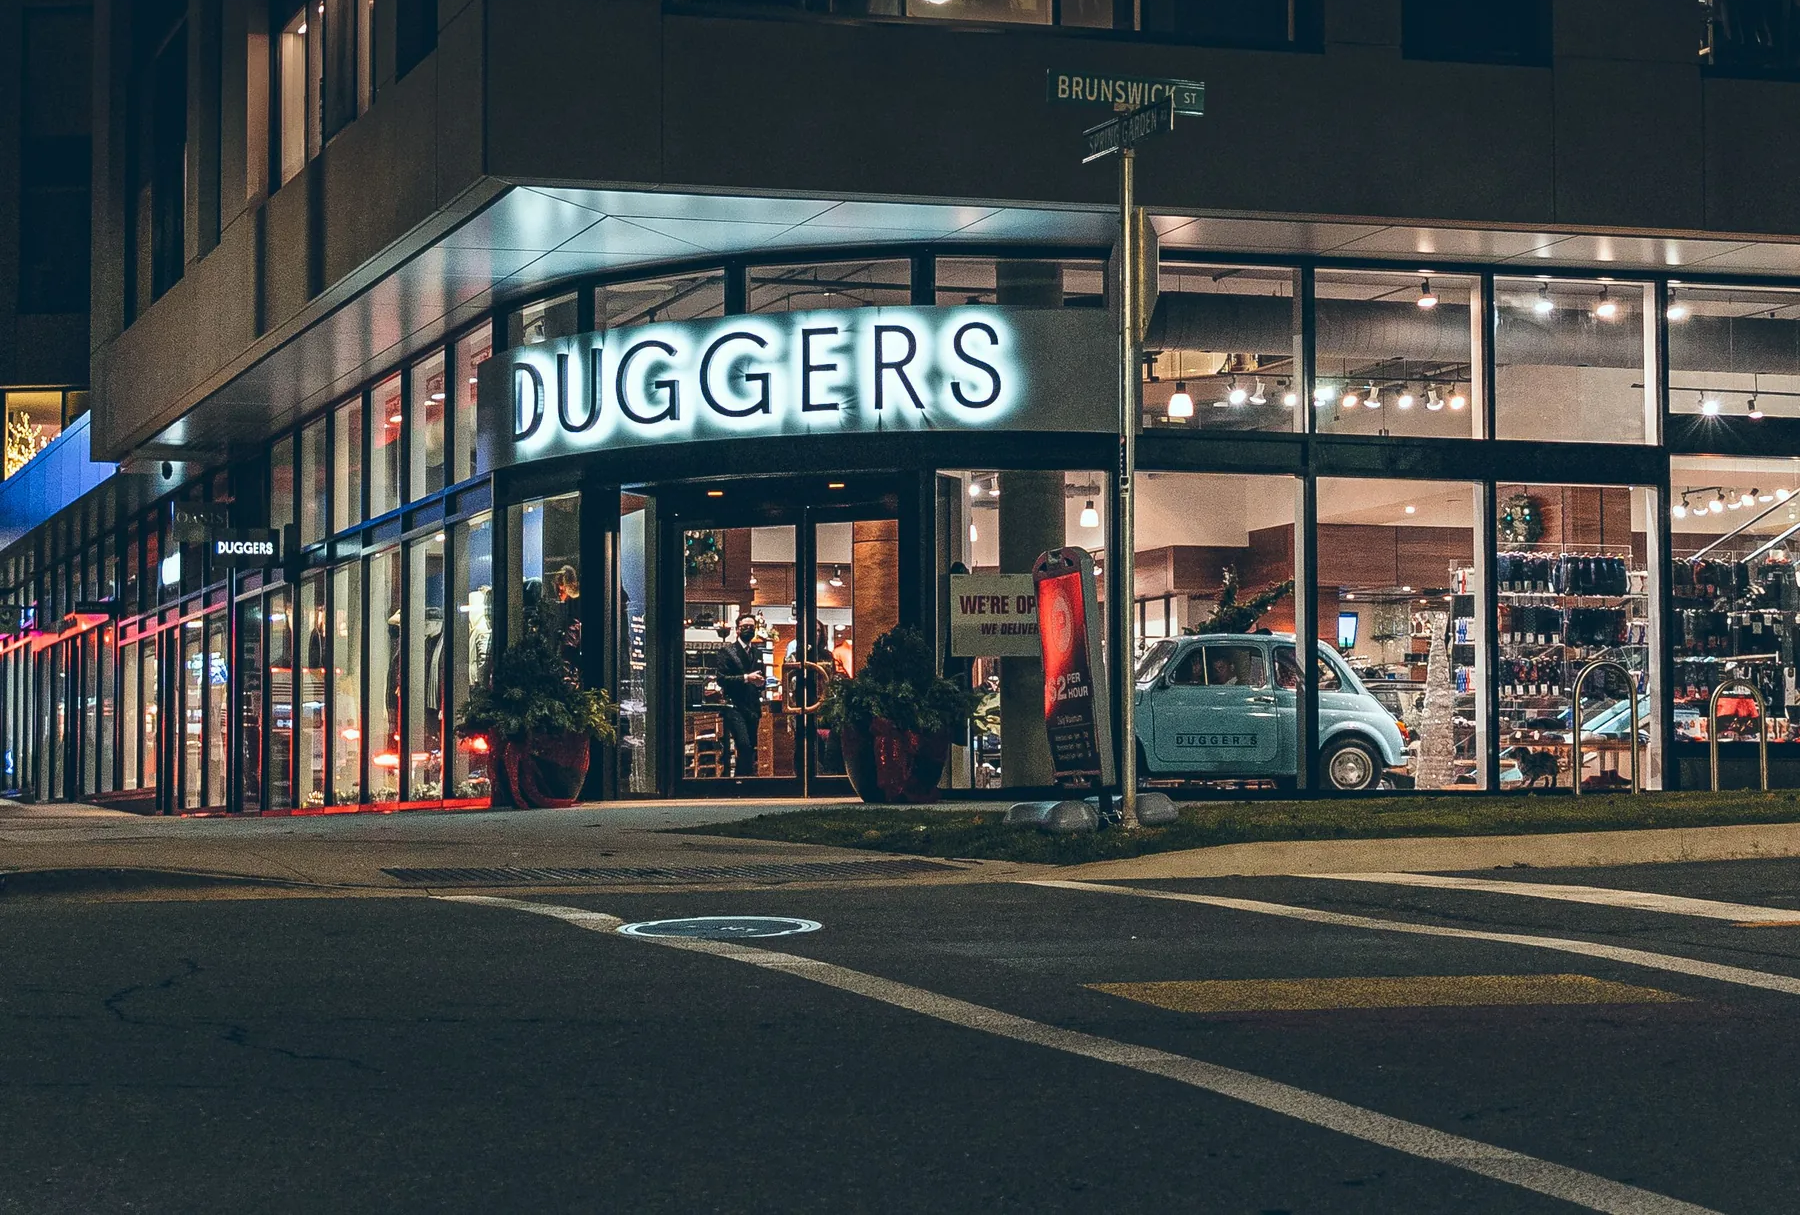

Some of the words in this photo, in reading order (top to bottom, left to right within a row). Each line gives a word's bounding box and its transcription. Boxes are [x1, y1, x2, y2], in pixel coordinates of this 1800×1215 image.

[1057, 74, 1177, 109] BRUNSWICK
[1183, 91, 1197, 104] ST
[1088, 123, 1121, 155] SPRING
[1121, 107, 1157, 142] GARDEN
[513, 321, 1002, 443] DUGGERS
[217, 540, 274, 555] DUGGERS
[959, 595, 1010, 615] WE'RE
[1016, 595, 1036, 615] OP
[981, 622, 998, 635] WE
[1066, 671, 1081, 685] PER
[1067, 685, 1089, 699] HOUR
[1175, 736, 1258, 746] DUGGER'S
